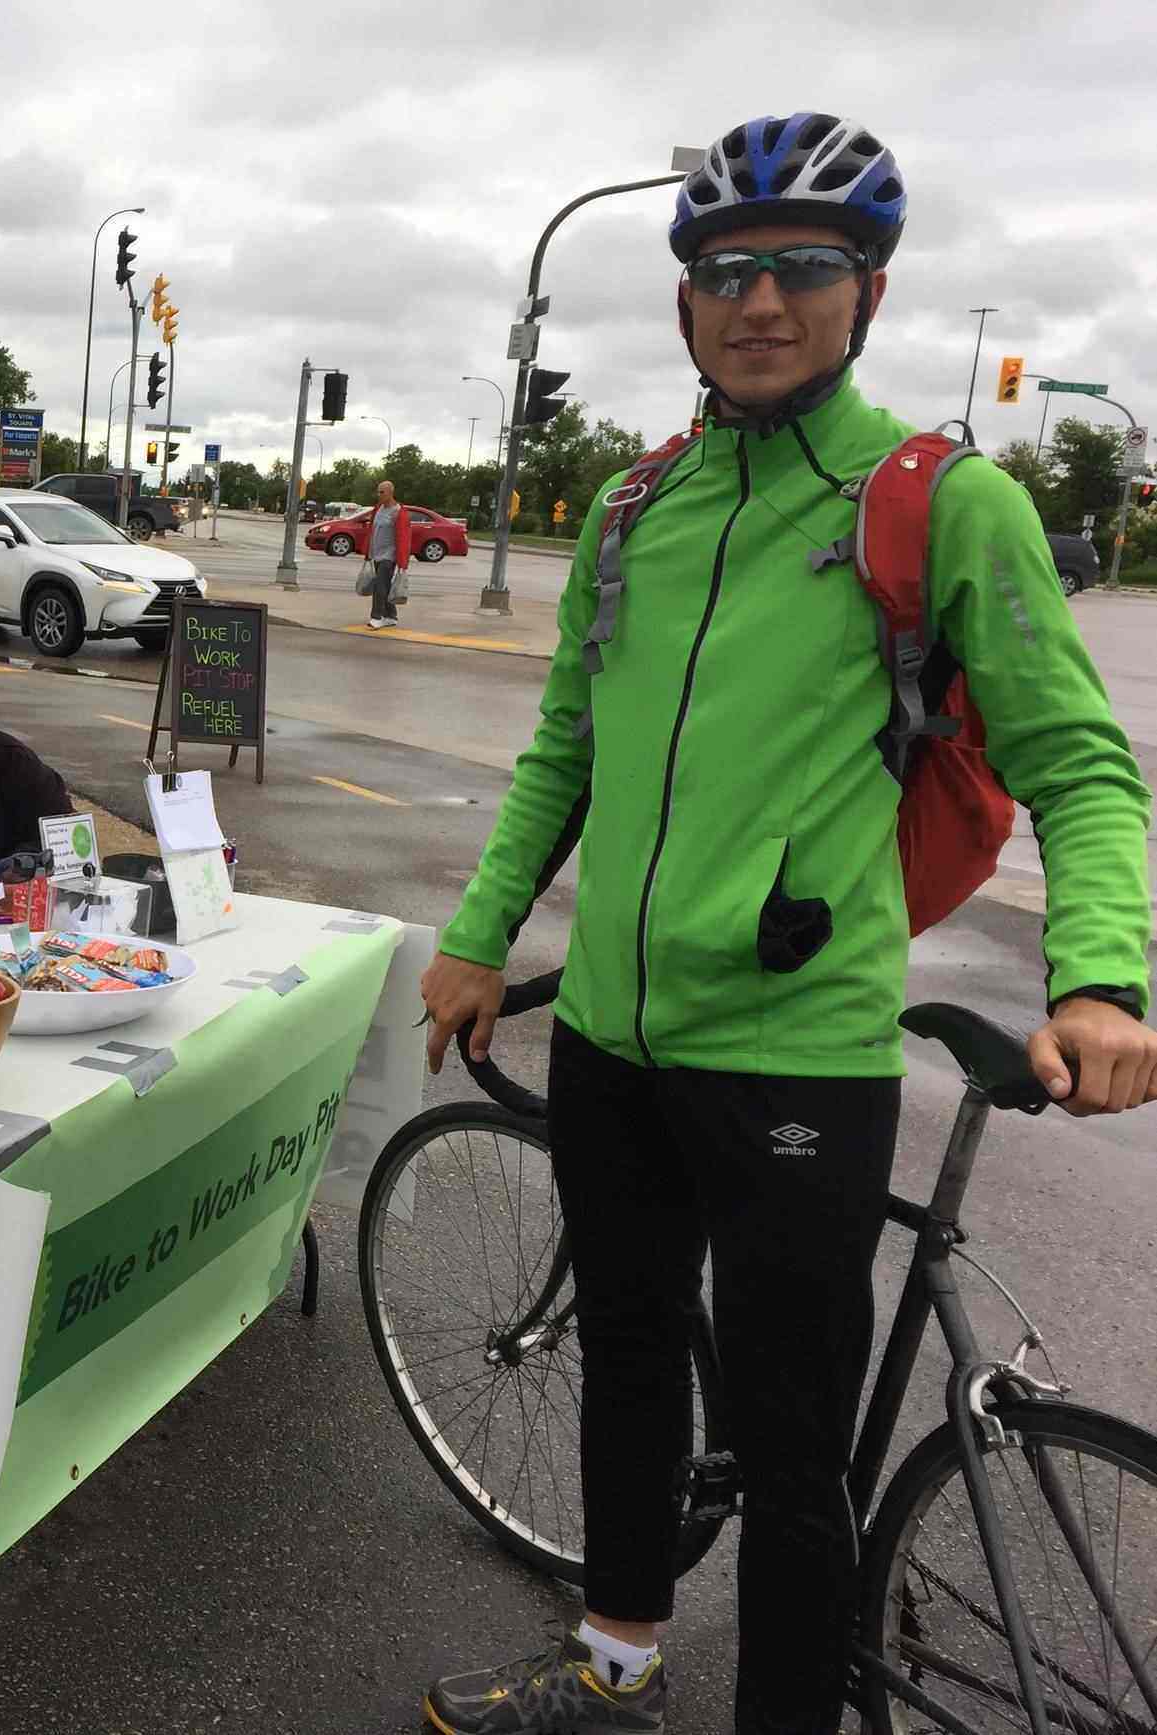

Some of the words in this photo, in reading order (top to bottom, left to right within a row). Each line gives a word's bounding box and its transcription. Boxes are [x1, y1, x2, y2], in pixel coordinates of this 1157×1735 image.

[186, 616, 228, 641] BIKE
[231, 621, 252, 643] TO
[194, 644, 241, 668] WORK
[183, 665, 212, 687] PIT
[182, 692, 244, 718] REFUEL
[203, 719, 244, 737] HERE
[773, 1145, 816, 1156] umbro
[56, 1254, 136, 1334] Bike
[146, 1224, 179, 1273] to
[189, 1152, 260, 1240] Work
[263, 1125, 311, 1184] Day
[313, 1092, 341, 1145] Pit
